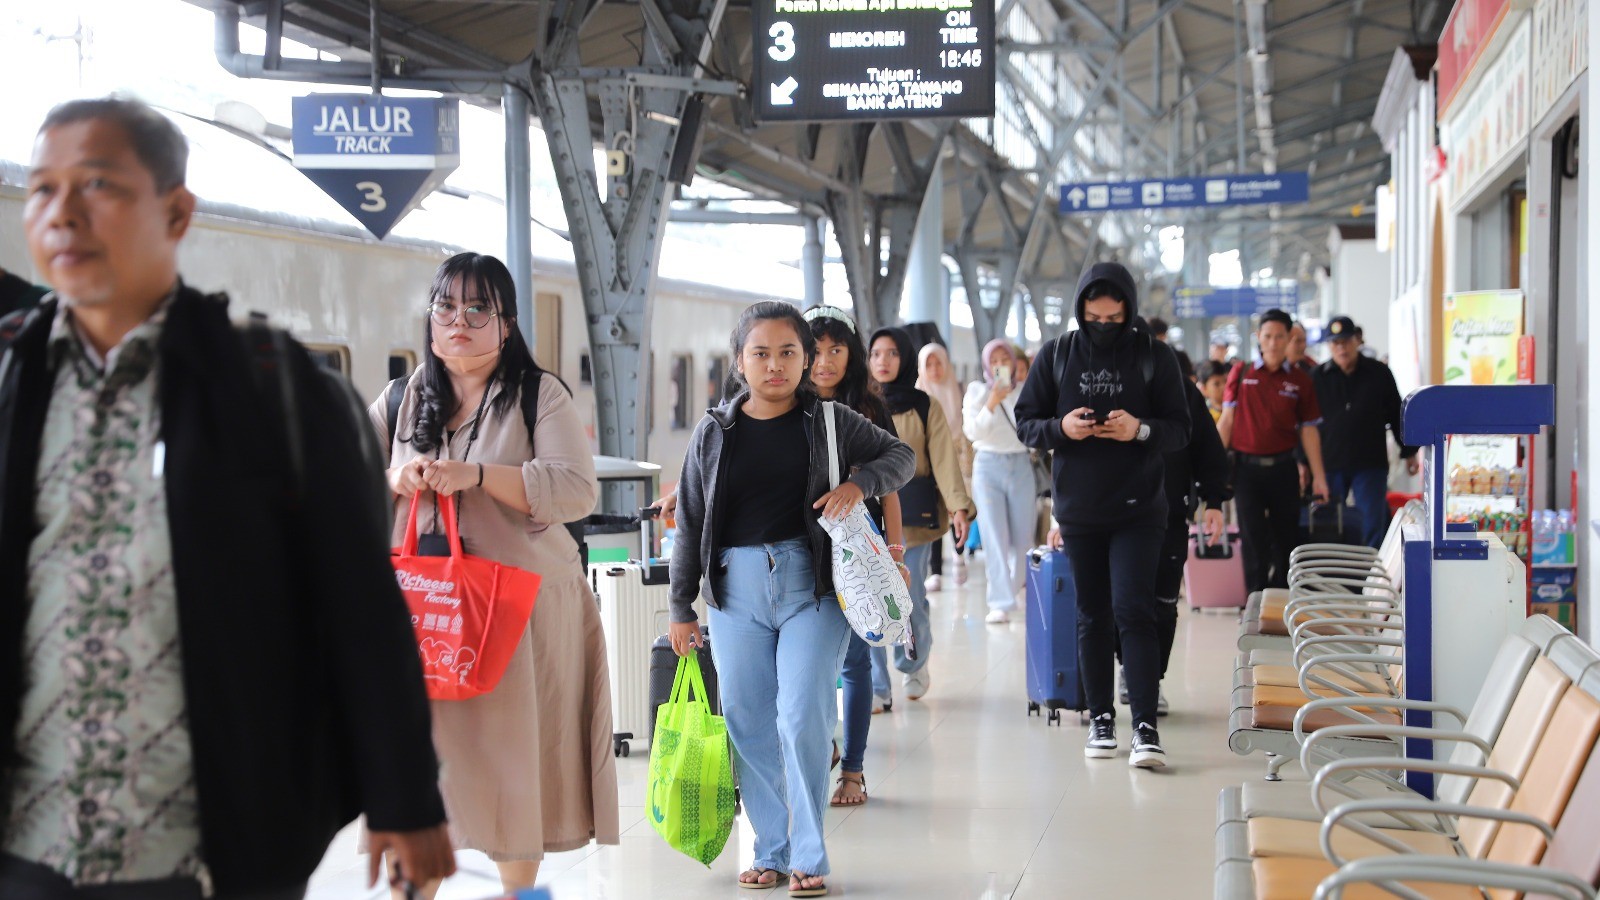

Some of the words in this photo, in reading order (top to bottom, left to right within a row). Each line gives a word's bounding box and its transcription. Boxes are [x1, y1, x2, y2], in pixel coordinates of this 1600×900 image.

[946, 10, 971, 26] ON
[767, 21, 796, 62] 3
[829, 31, 905, 48] MENOREH
[939, 27, 978, 44] TIME
[867, 68, 914, 84] Tujuan
[822, 83, 900, 98] SEMARANG
[902, 80, 963, 96] TAWANG
[846, 96, 886, 111] BANK
[887, 94, 943, 110] JATENG
[313, 105, 413, 132] JALUR
[334, 136, 392, 153] TRACK
[355, 181, 387, 212] 3
[394, 569, 455, 592] Richeese
[423, 592, 461, 609] Factory
